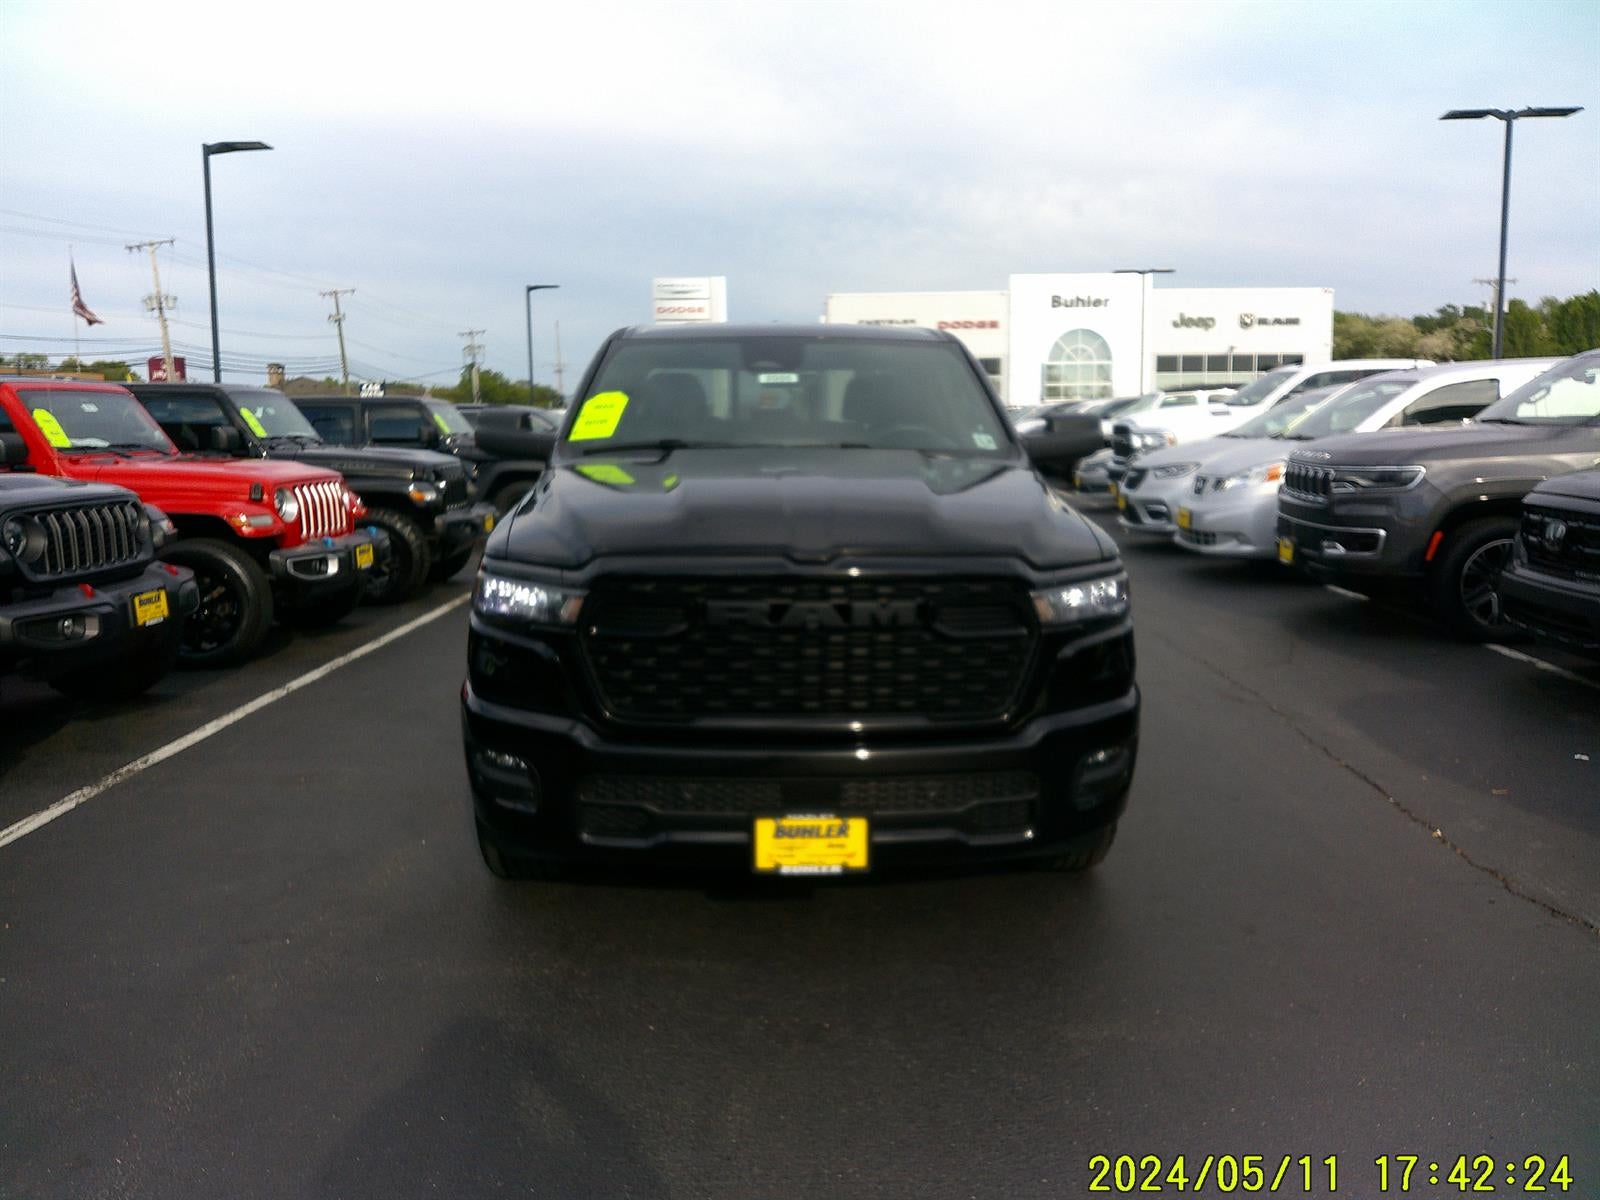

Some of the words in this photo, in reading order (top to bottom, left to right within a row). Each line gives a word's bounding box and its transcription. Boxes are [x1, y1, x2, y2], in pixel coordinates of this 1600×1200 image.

[1051, 295, 1110, 308] Buhler
[656, 306, 705, 314] DODGE
[937, 320, 999, 329] DODGE
[1172, 312, 1216, 331] Jeep
[706, 599, 918, 627] RAM
[773, 823, 849, 839] BUHLER
